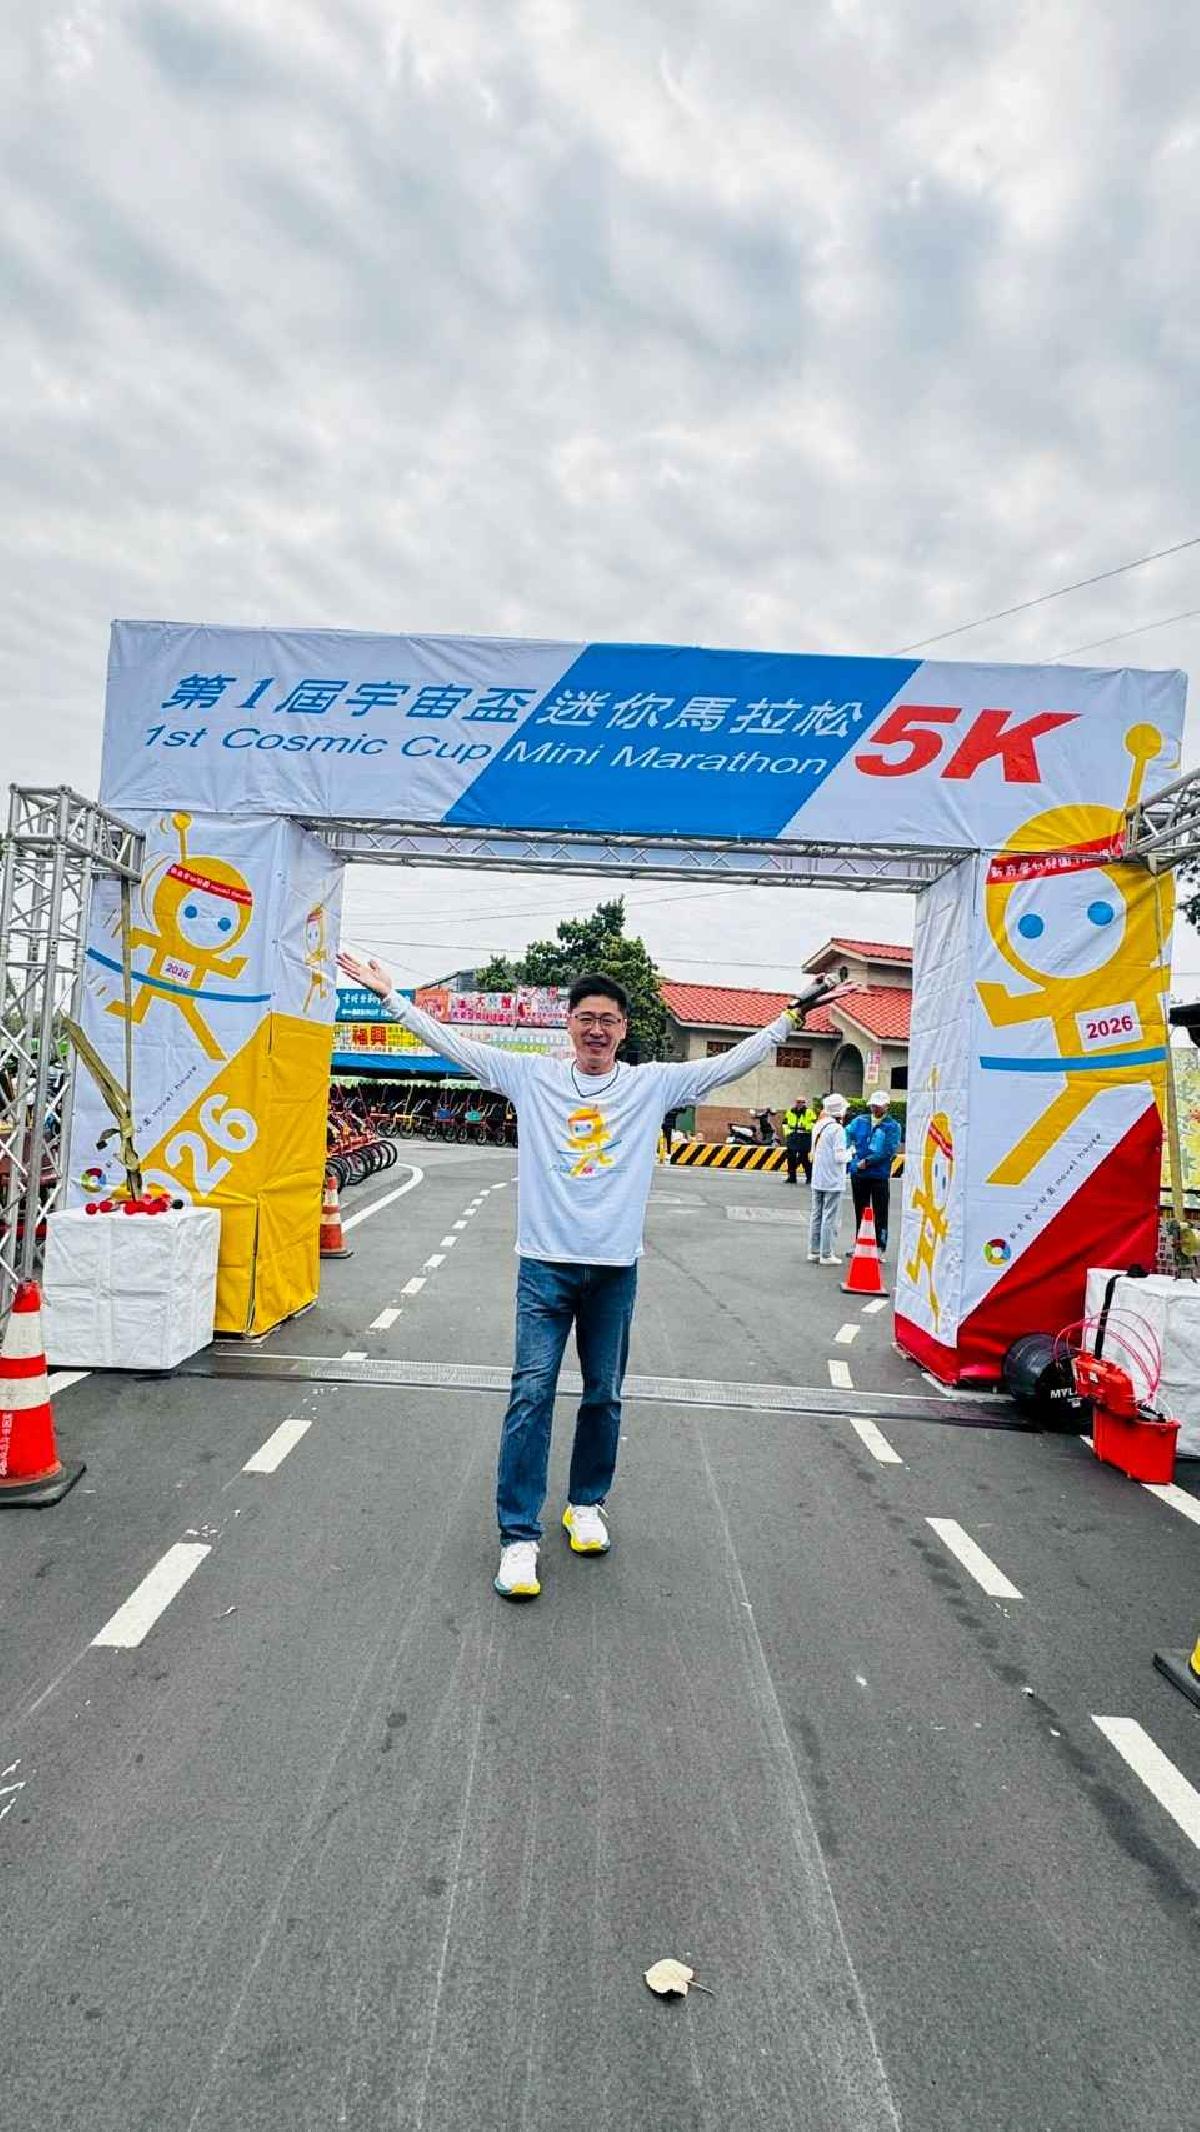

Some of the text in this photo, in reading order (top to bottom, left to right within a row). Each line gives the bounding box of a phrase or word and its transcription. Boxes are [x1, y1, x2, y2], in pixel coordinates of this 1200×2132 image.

[161, 673, 1081, 784] 第1屆宇宙盃迷你馬拉松 5K
[145, 724, 829, 776] 1st Cosmic Cup Mini Marathon
[166, 962, 190, 979] 2026
[1086, 1015, 1133, 1039] 2026
